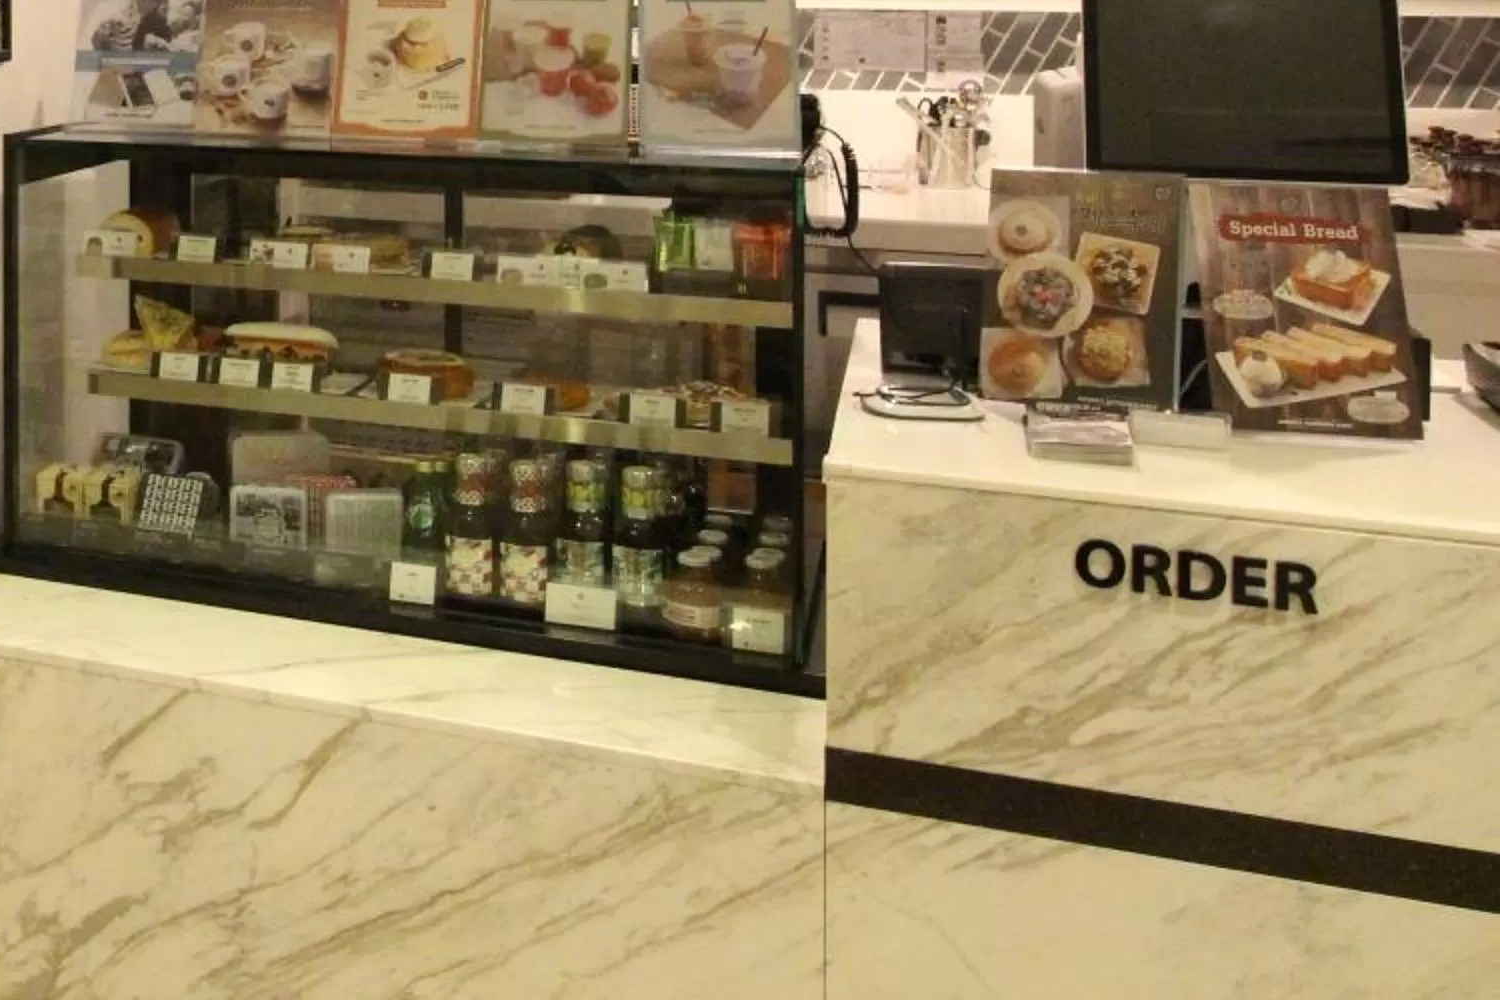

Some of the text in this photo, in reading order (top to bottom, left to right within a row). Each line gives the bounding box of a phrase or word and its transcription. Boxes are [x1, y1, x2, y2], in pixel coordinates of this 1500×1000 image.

[1229, 220, 1359, 241] Special Bread
[1074, 539, 1319, 615] ORDER
